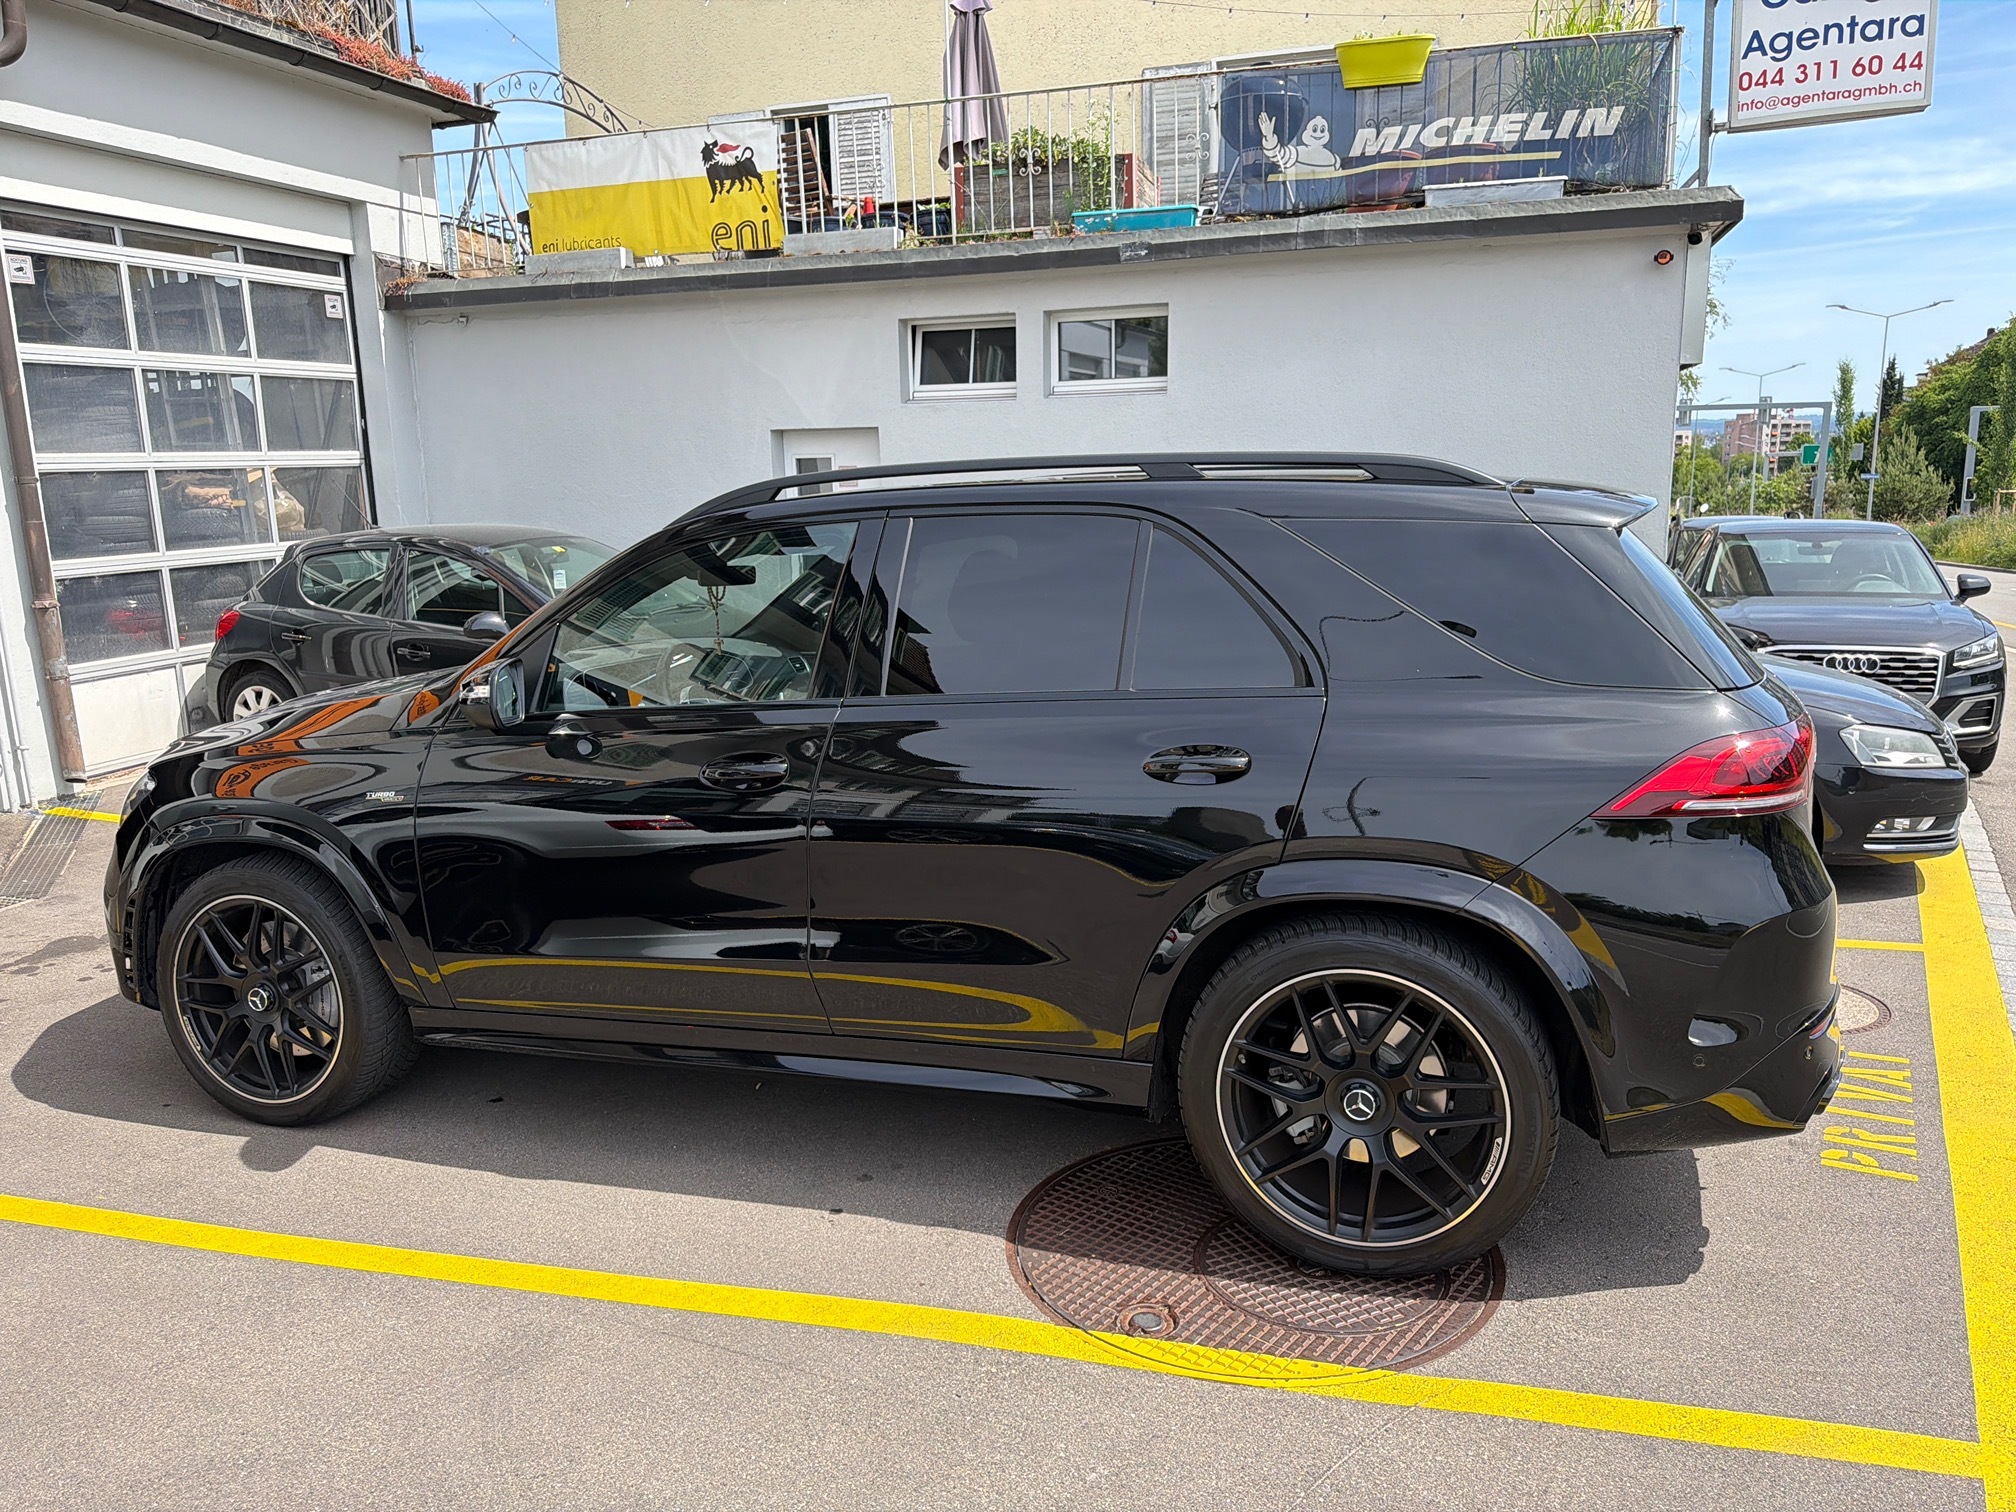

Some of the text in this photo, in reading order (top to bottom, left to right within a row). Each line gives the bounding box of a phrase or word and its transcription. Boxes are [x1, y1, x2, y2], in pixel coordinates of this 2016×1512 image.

[1741, 13, 1926, 62] Agentara
[1738, 51, 1923, 92] 044 311 60 44
[1737, 80, 1922, 113] info@agentaragmbh.ch
[1349, 106, 1625, 157] MICHELIN
[542, 235, 622, 253] eni lubricants
[711, 205, 771, 251] eni
